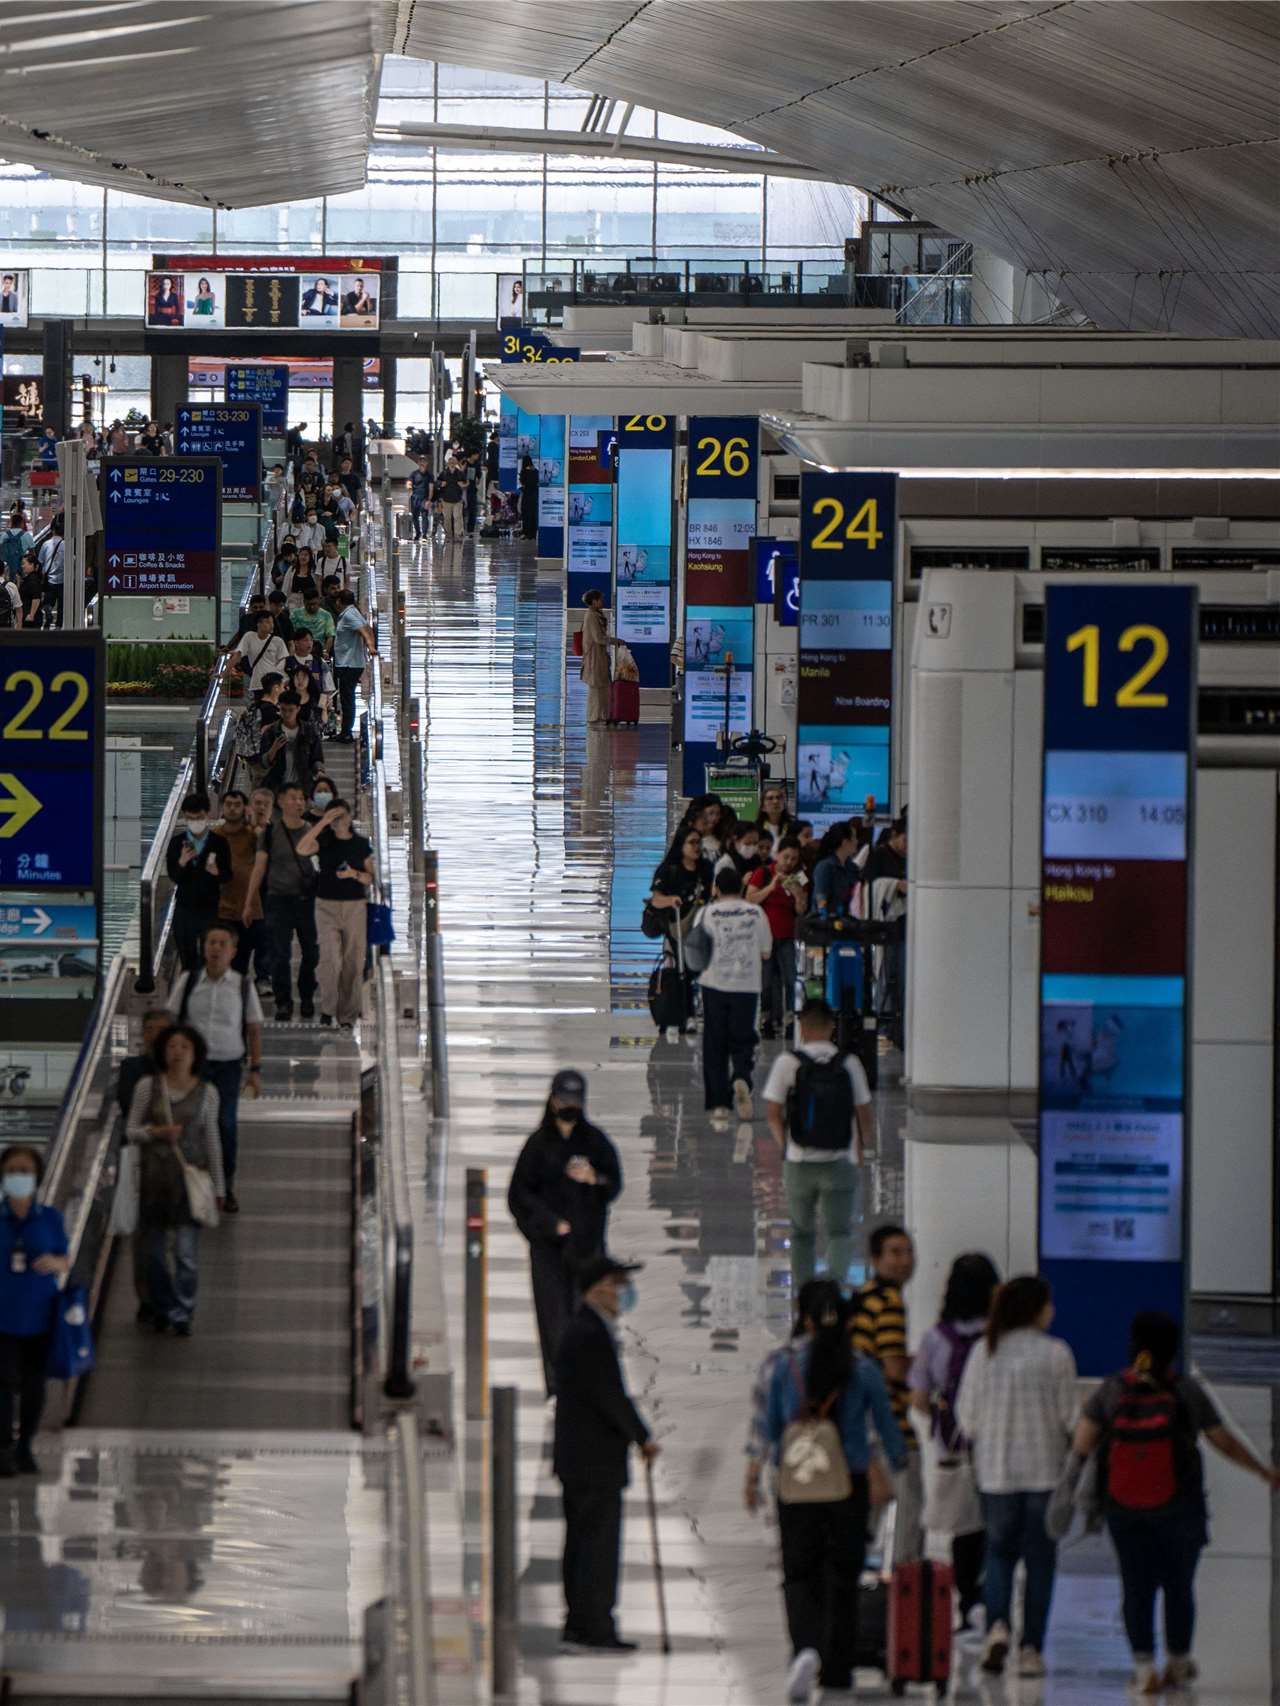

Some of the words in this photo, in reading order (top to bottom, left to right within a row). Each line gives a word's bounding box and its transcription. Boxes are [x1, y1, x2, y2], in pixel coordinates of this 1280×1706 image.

[216, 411, 250, 421] 33-230
[696, 437, 750, 476] 26
[160, 469, 204, 483] 29-230
[688, 524, 701, 533] BR
[811, 498, 884, 550] 24
[688, 536, 701, 545] HX
[688, 562, 723, 571] Kaohsiung
[139, 582, 159, 590] Airport
[802, 614, 818, 625] PR
[801, 667, 831, 677] Manila
[1066, 624, 1169, 708] 12
[855, 696, 890, 709] Boarding
[1048, 803, 1072, 823] CX
[18, 854, 49, 868] 分鐘
[18, 869, 62, 881] Minutes
[1045, 885, 1094, 902] Haikou
